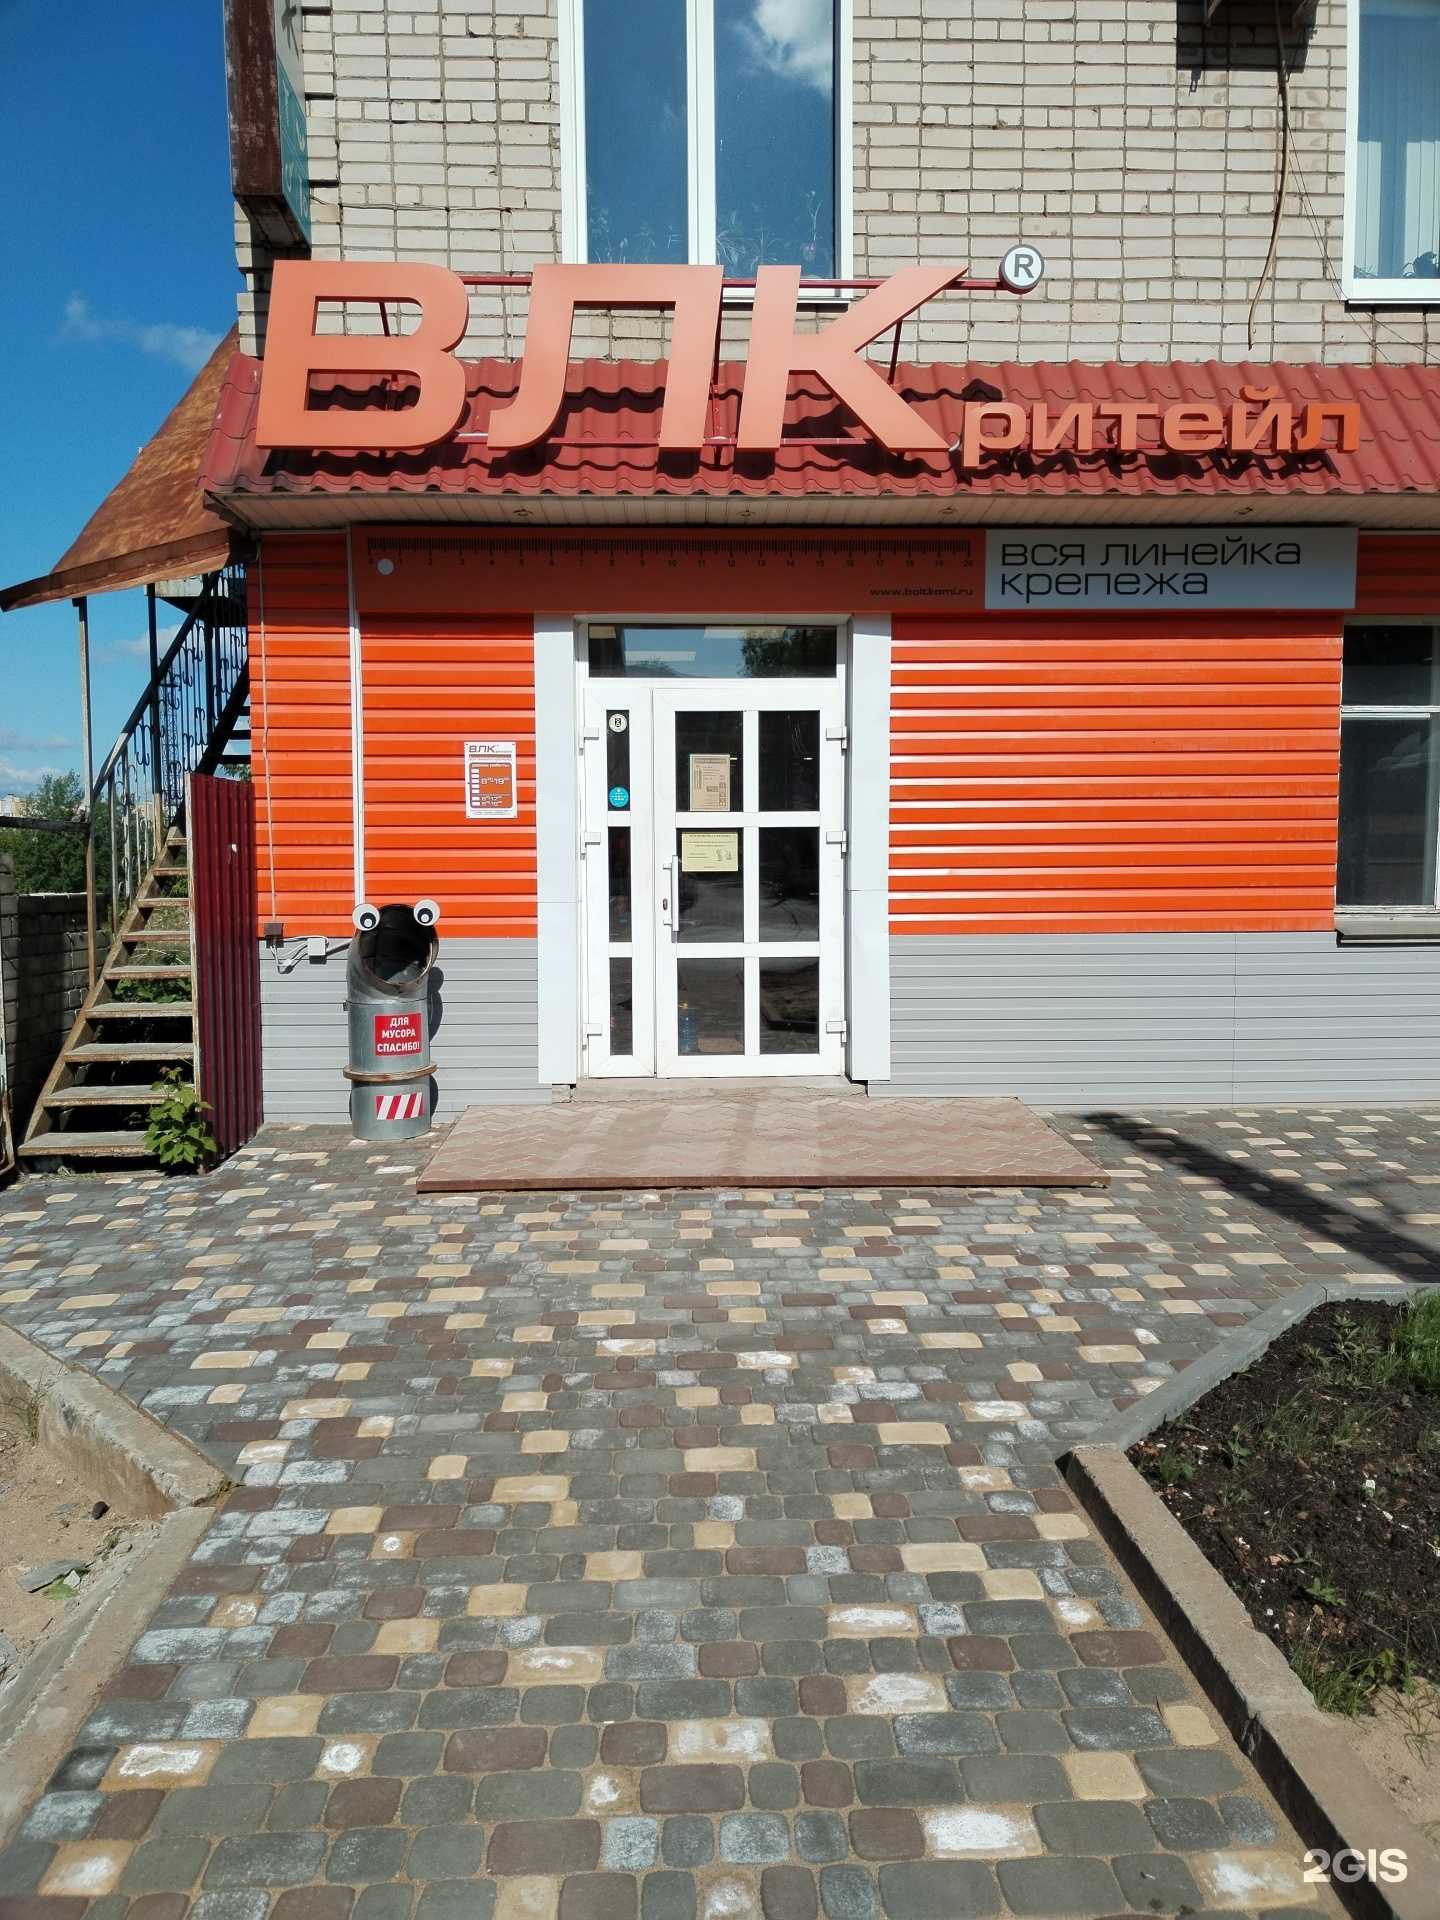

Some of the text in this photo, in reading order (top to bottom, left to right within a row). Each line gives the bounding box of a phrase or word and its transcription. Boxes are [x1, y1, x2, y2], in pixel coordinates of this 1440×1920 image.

[256, 259, 968, 451] ВЛК
[963, 385, 1361, 467] ритейл
[1001, 535, 1302, 567] вся линейка
[1001, 571, 1209, 604] крепежа
[381, 1028, 416, 1039] МУСОРА
[390, 1016, 409, 1028] ДЛЯ
[377, 1040, 420, 1052] СПАСИБО!
